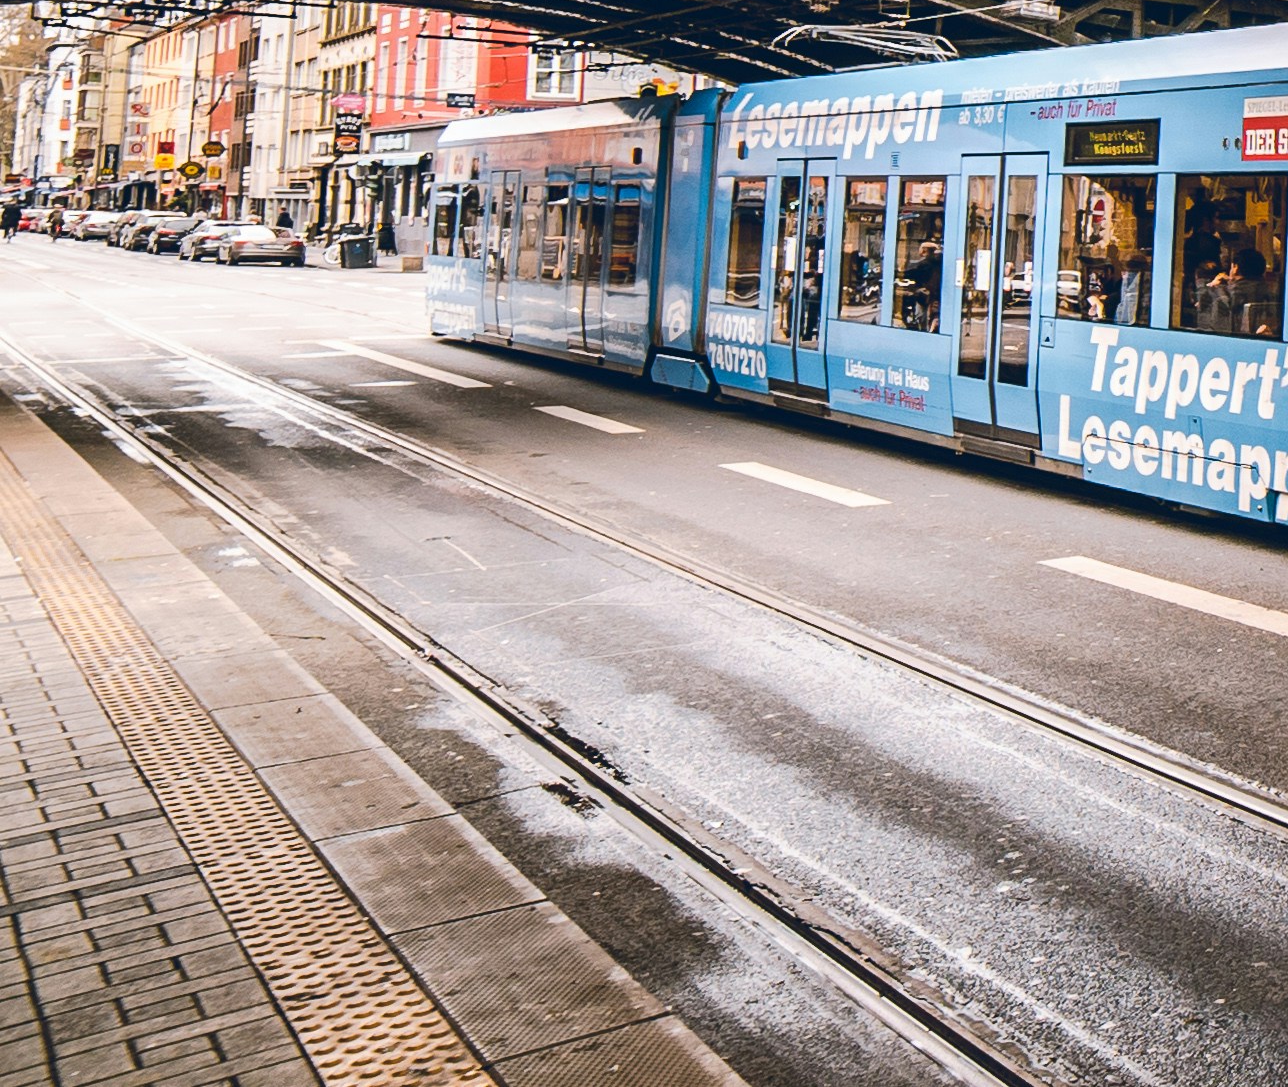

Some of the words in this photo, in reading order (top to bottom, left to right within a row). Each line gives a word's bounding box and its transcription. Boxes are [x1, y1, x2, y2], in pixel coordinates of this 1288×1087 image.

[958, 109, 970, 126] ab
[973, 106, 994, 126] 3,30
[1086, 97, 1117, 117] Privat
[727, 88, 944, 161] Lesemappen
[1093, 142, 1144, 156] Königsforst
[1245, 128, 1276, 155] DER
[709, 342, 767, 379] 7407270
[844, 359, 886, 387] Lieferung
[887, 366, 902, 386] frei
[904, 369, 930, 392] Haus
